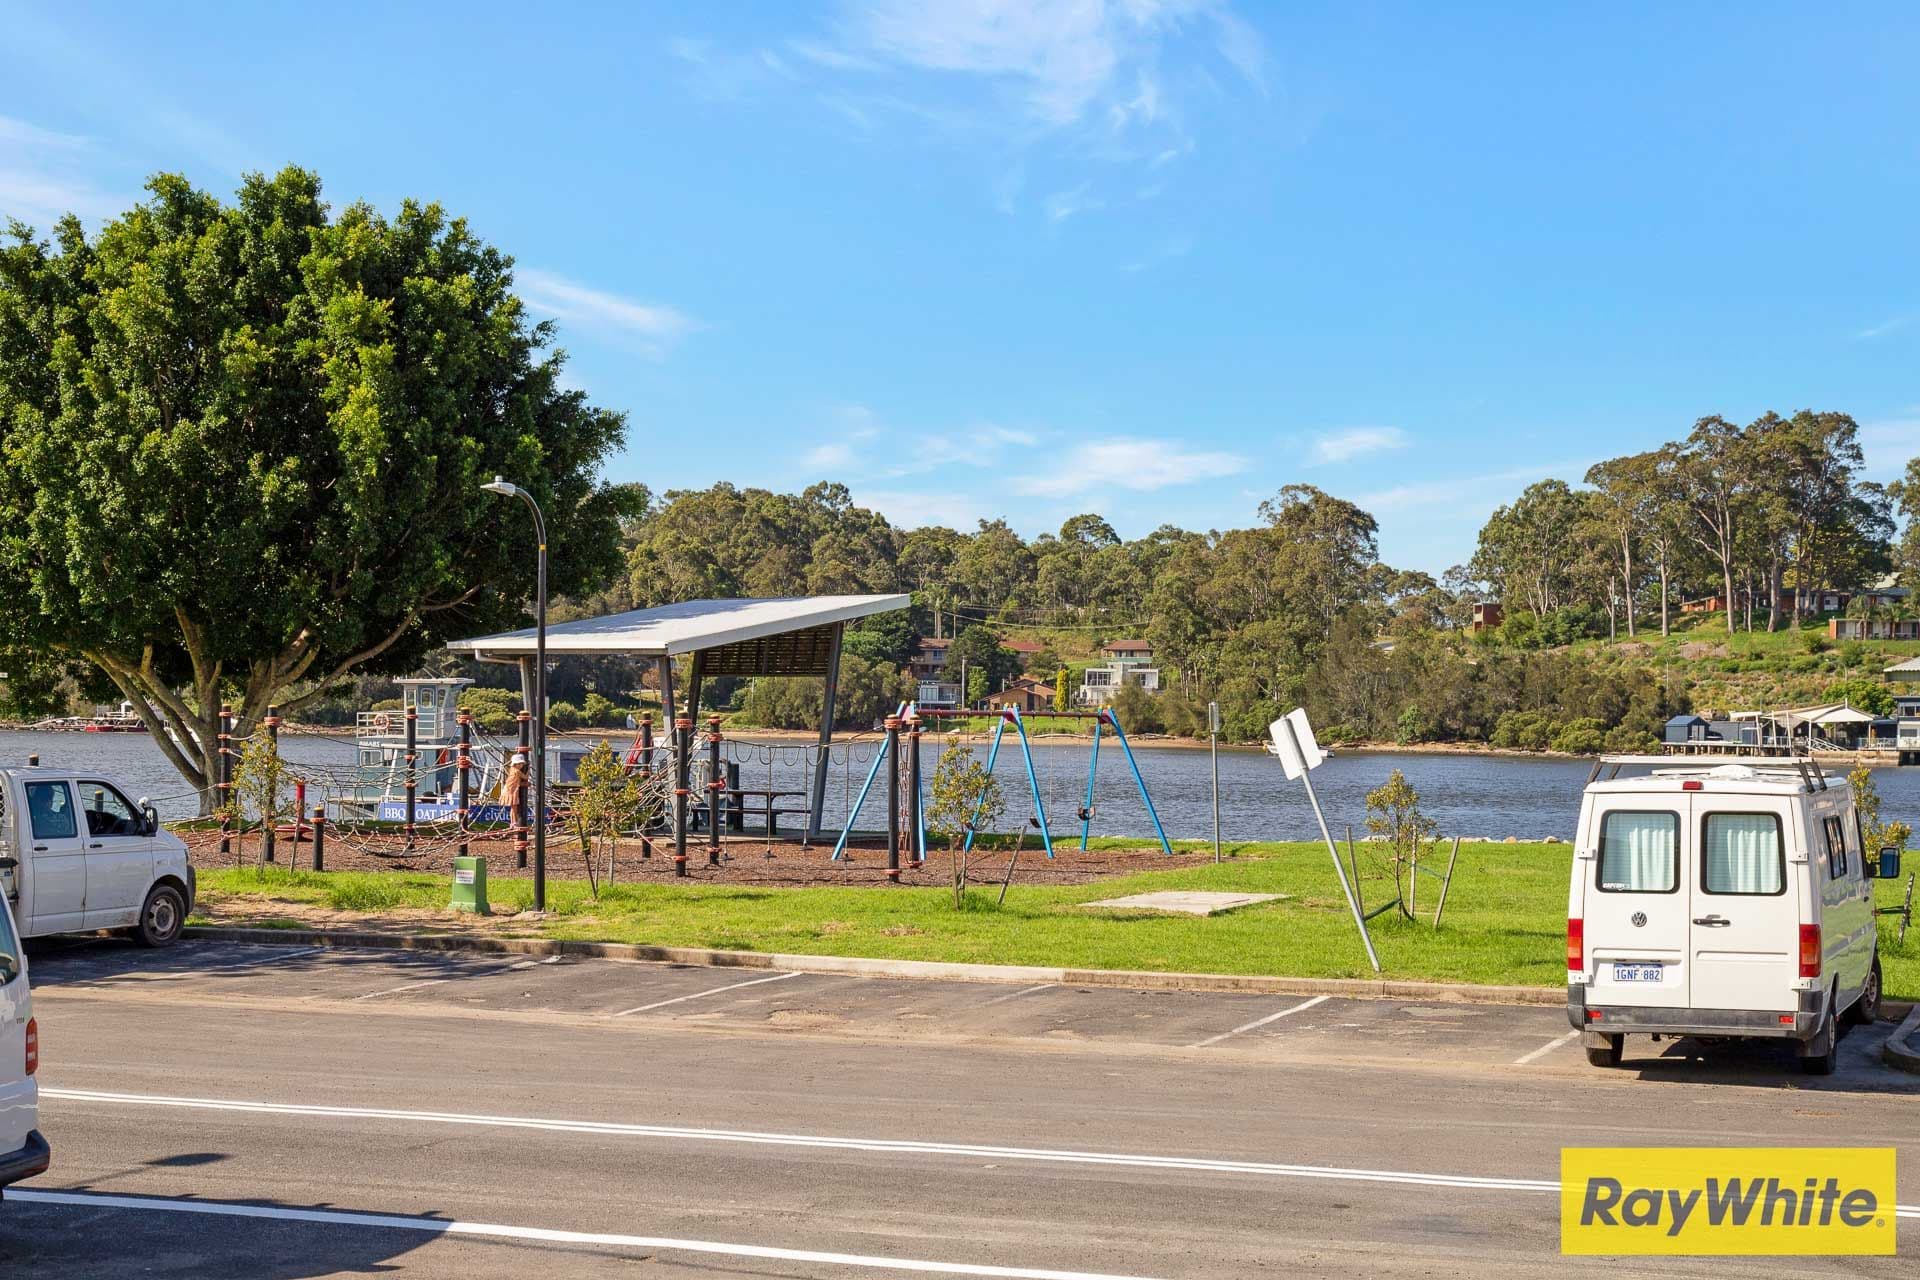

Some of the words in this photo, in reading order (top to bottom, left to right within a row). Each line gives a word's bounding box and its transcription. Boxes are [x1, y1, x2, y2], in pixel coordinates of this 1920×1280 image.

[384, 807, 406, 821] BBQ
[1616, 969, 1640, 980] 1GNF
[1643, 969, 1660, 981] 882
